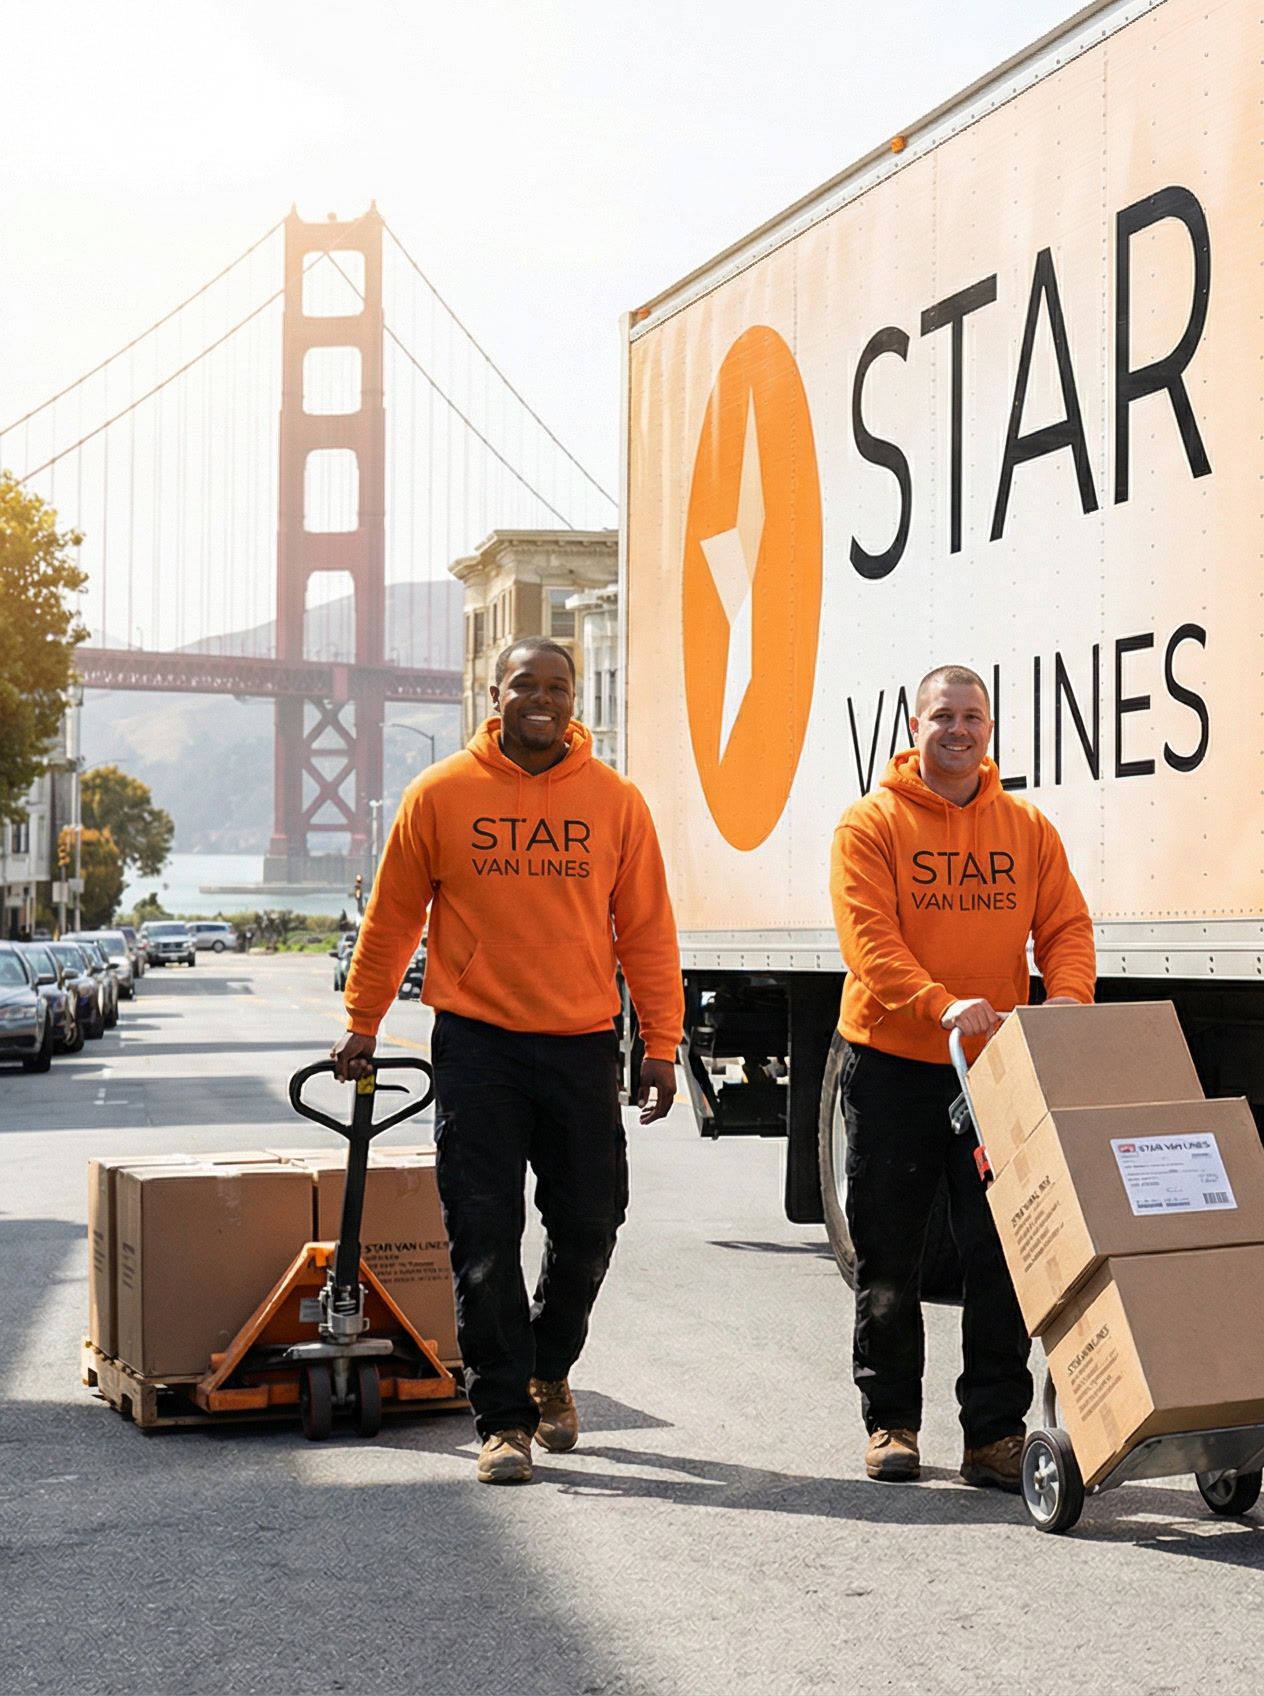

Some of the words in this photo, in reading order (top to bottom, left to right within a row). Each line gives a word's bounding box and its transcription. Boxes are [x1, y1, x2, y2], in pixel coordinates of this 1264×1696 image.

[849, 186, 1213, 580] STAR
[846, 686, 915, 798] VA
[993, 623, 1209, 792] LINES
[471, 816, 591, 854] STAR
[471, 857, 520, 877] VAN
[527, 859, 590, 879] LINES
[911, 850, 1016, 887] STAR
[911, 891, 954, 911] VAN
[959, 891, 1017, 911] LINES
